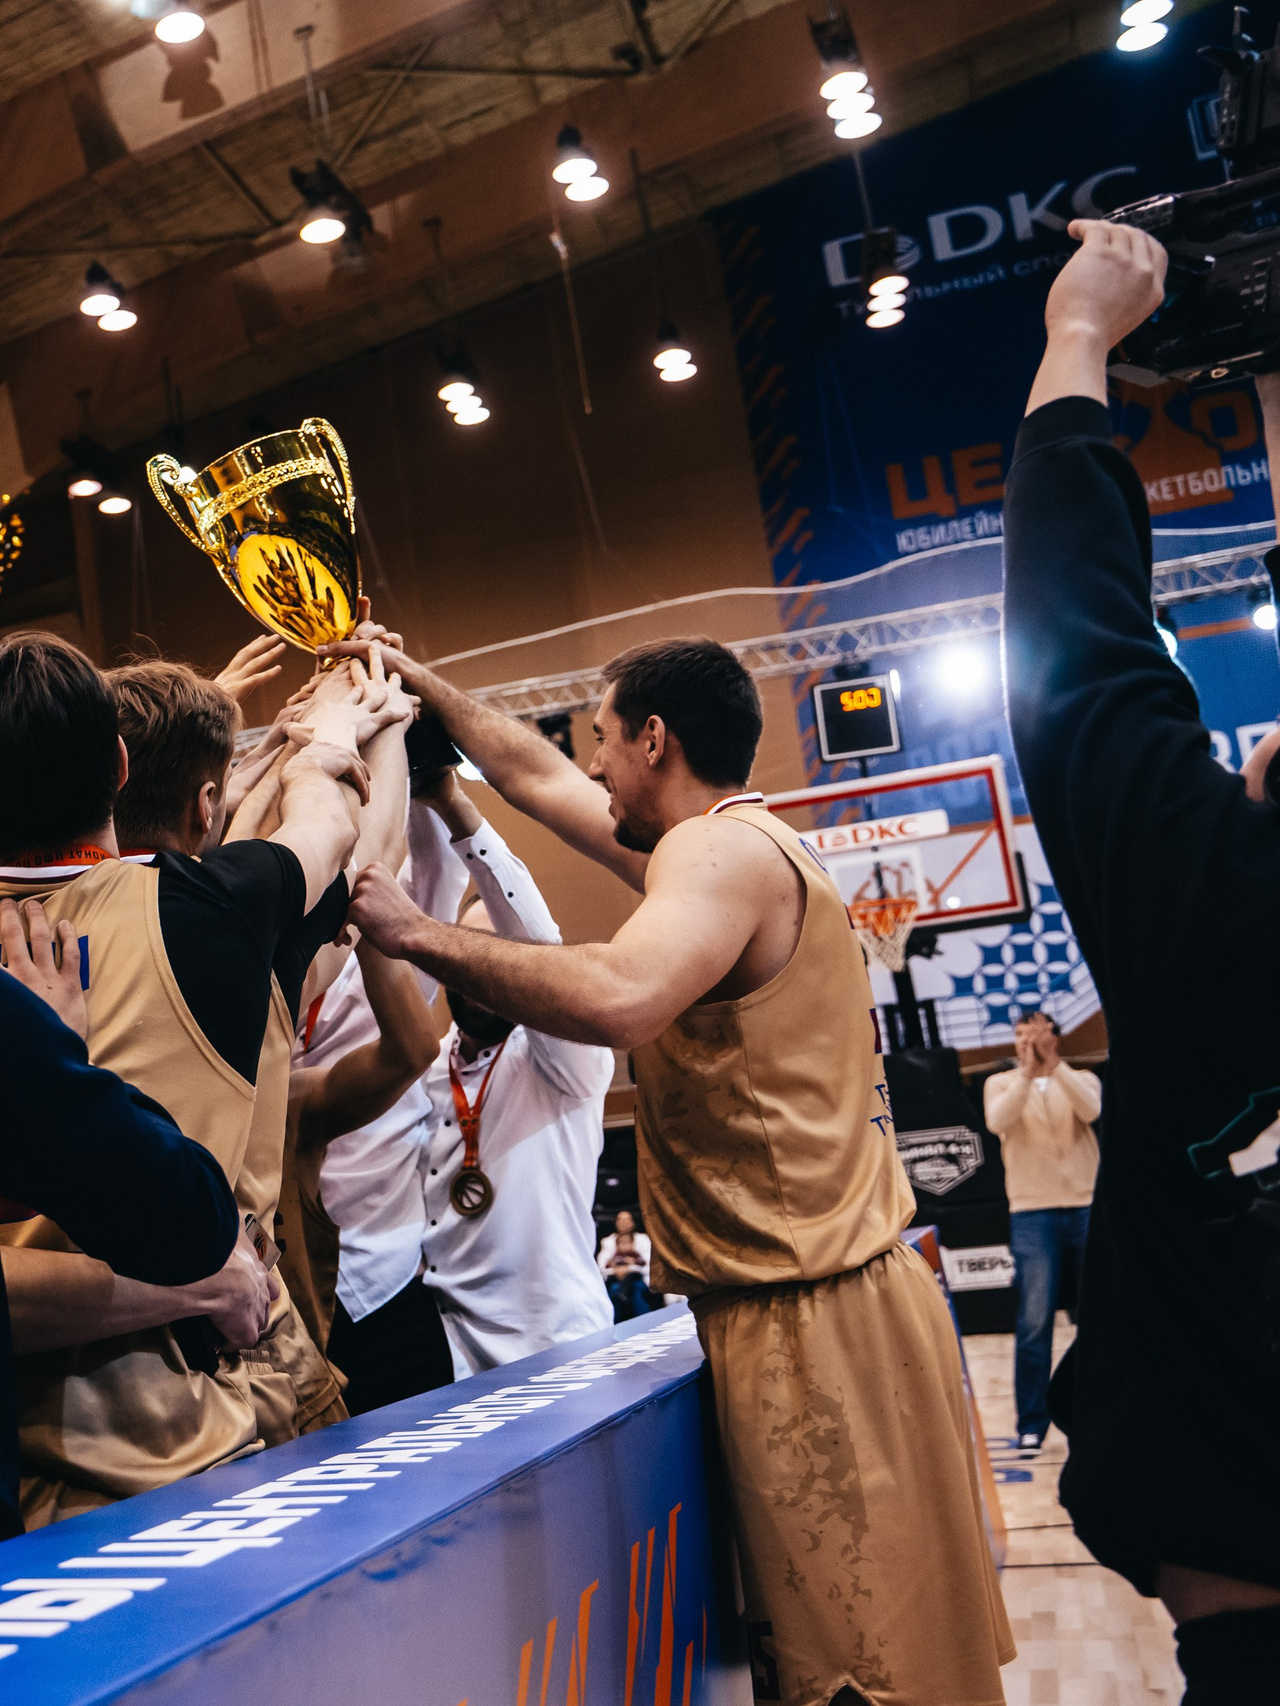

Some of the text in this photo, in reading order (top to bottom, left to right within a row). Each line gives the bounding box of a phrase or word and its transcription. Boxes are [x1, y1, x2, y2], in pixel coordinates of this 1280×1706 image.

[1144, 459, 1270, 501] КЕТБОЛЬН
[896, 510, 1004, 553] ЮБИЛЕЙН
[69, 849, 108, 861] ИОНАТ
[57, 1382, 593, 1569] ЦЕНТРАЛЬНОГО
